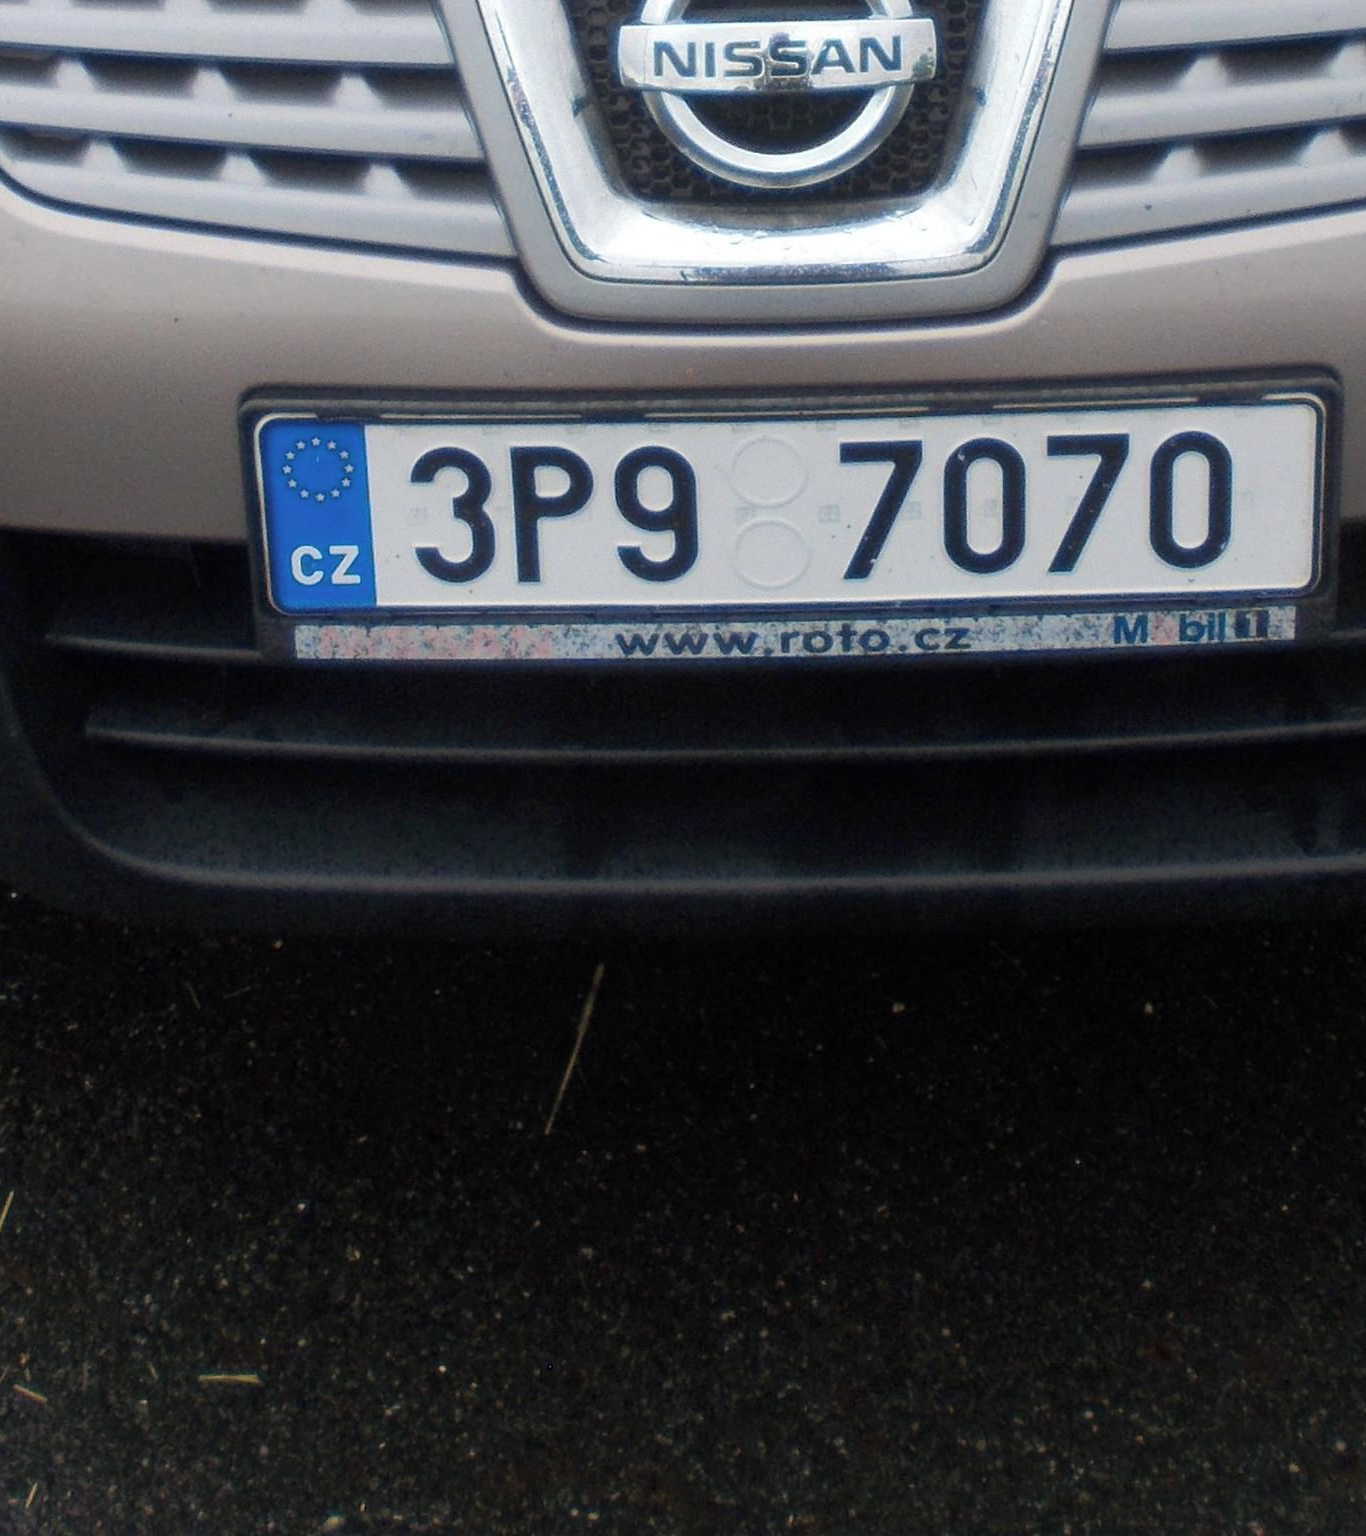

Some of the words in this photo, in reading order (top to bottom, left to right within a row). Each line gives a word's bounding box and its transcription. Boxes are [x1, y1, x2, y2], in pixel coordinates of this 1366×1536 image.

[652, 34, 903, 79] NISSAN
[409, 444, 700, 584] 3P9
[839, 430, 1234, 581] 7070
[290, 545, 362, 586] CZ
[614, 623, 972, 657] www.roto.cz
